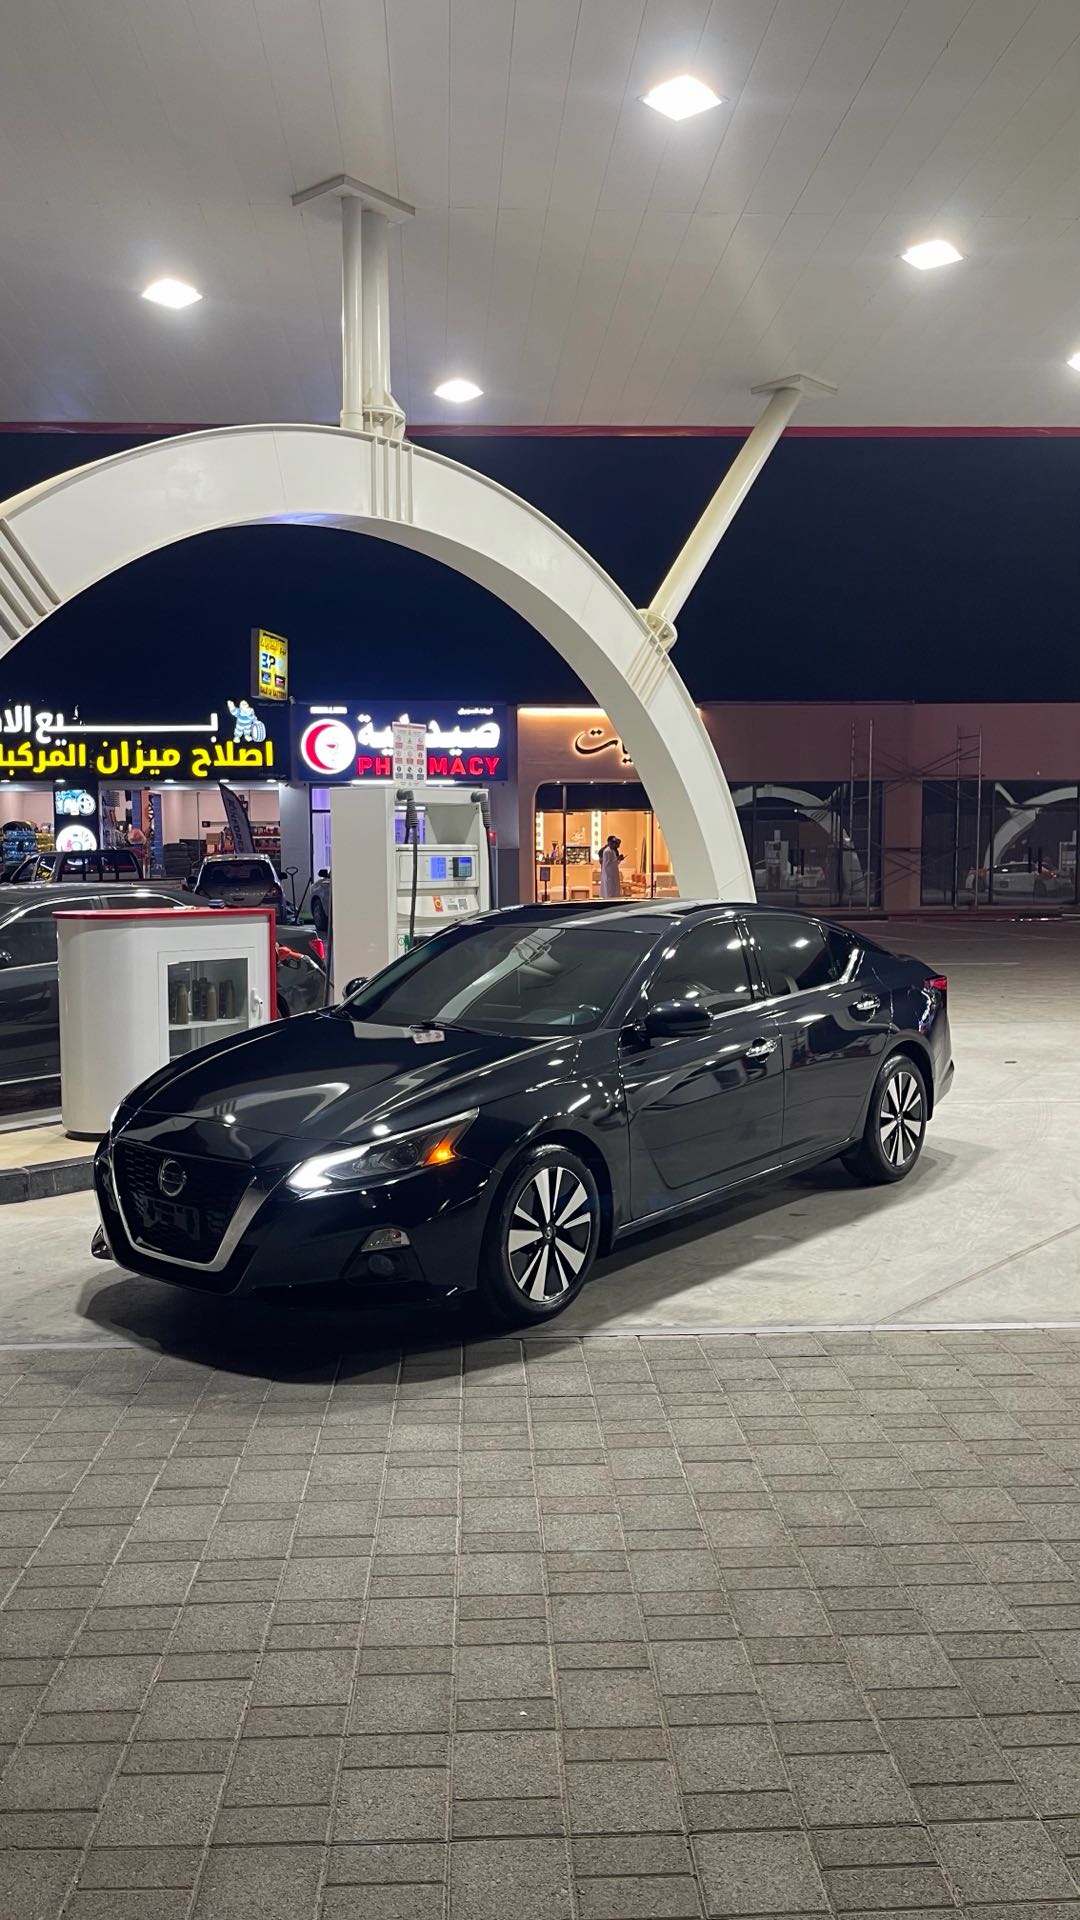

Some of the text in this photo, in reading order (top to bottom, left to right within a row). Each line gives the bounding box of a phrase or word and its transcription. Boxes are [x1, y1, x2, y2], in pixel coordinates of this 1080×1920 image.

[0, 705, 218, 746] بيع الا
[0, 740, 273, 777] اصلاح ميزان المركبا
[357, 757, 500, 776] PHMACY
